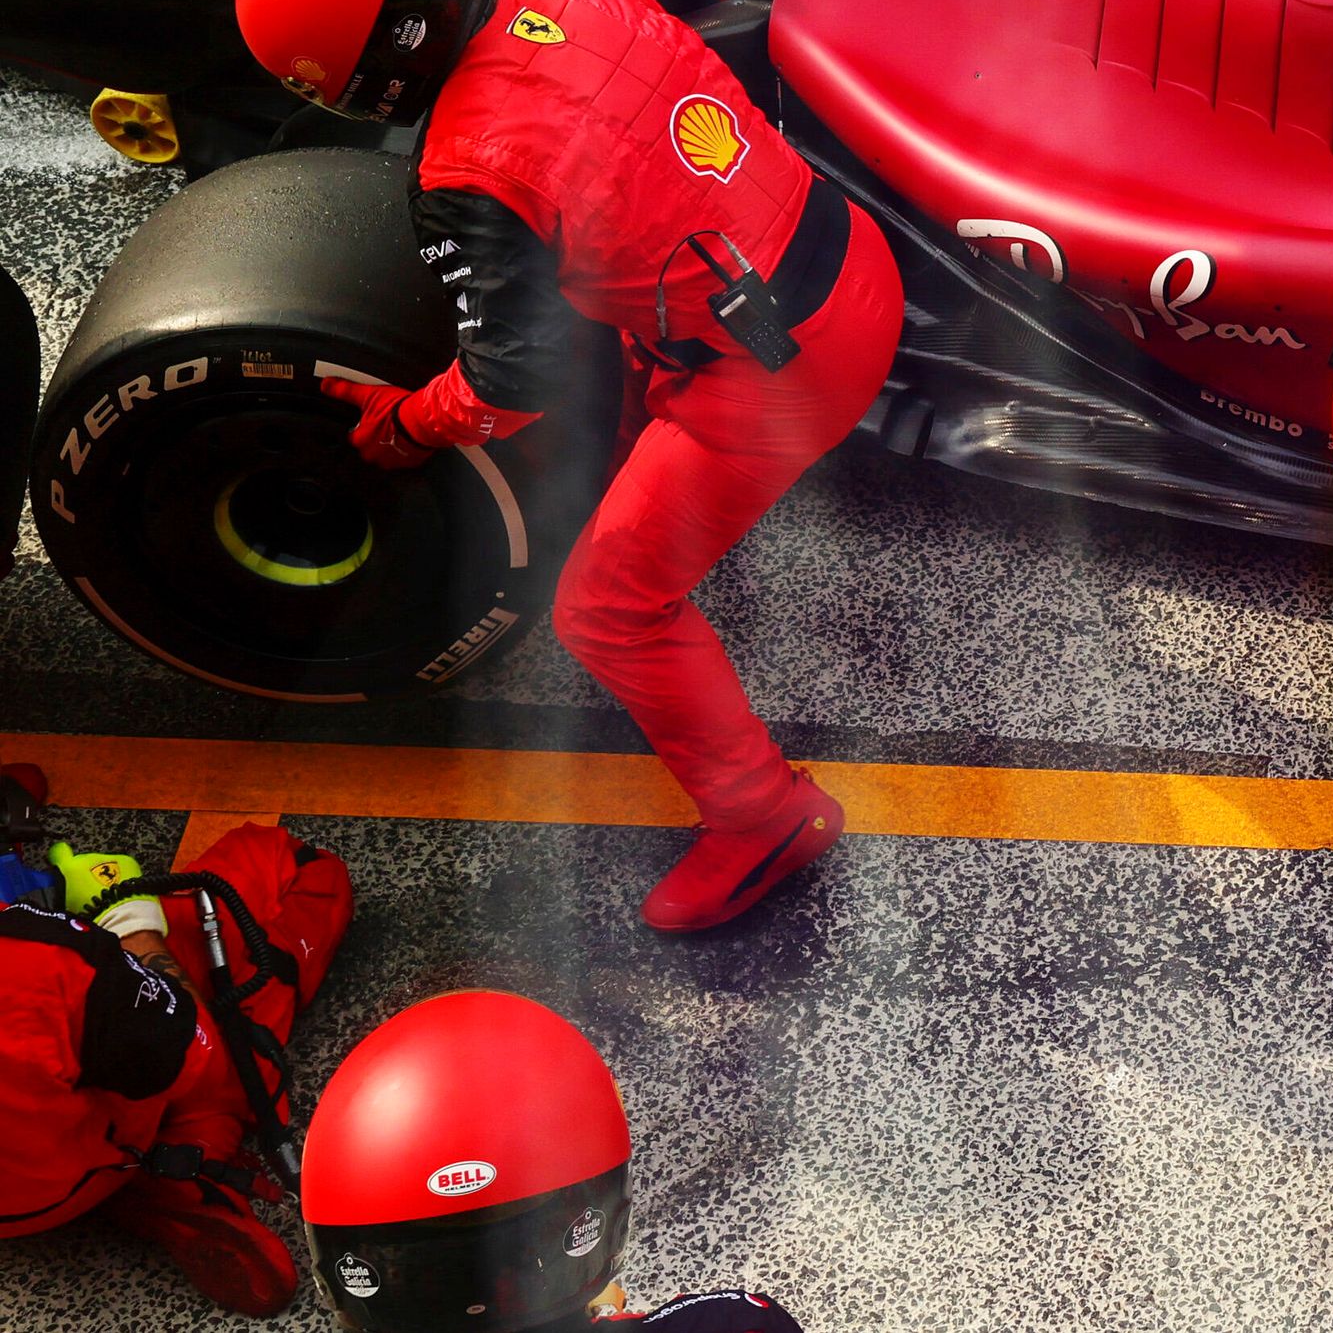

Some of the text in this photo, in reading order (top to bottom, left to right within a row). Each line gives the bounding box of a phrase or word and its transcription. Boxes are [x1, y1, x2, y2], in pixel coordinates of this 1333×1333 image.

[1199, 388, 1304, 438] brembo
[50, 356, 209, 525] P ZERO
[415, 606, 520, 684] PIRELLI
[438, 1168, 486, 1189] BELL
[444, 1182, 481, 1191] HELMETS
[572, 1218, 601, 1237] Estrella
[572, 1229, 598, 1248] Galicia
[340, 1265, 370, 1277] Estrella
[344, 1275, 372, 1287] Galicia
